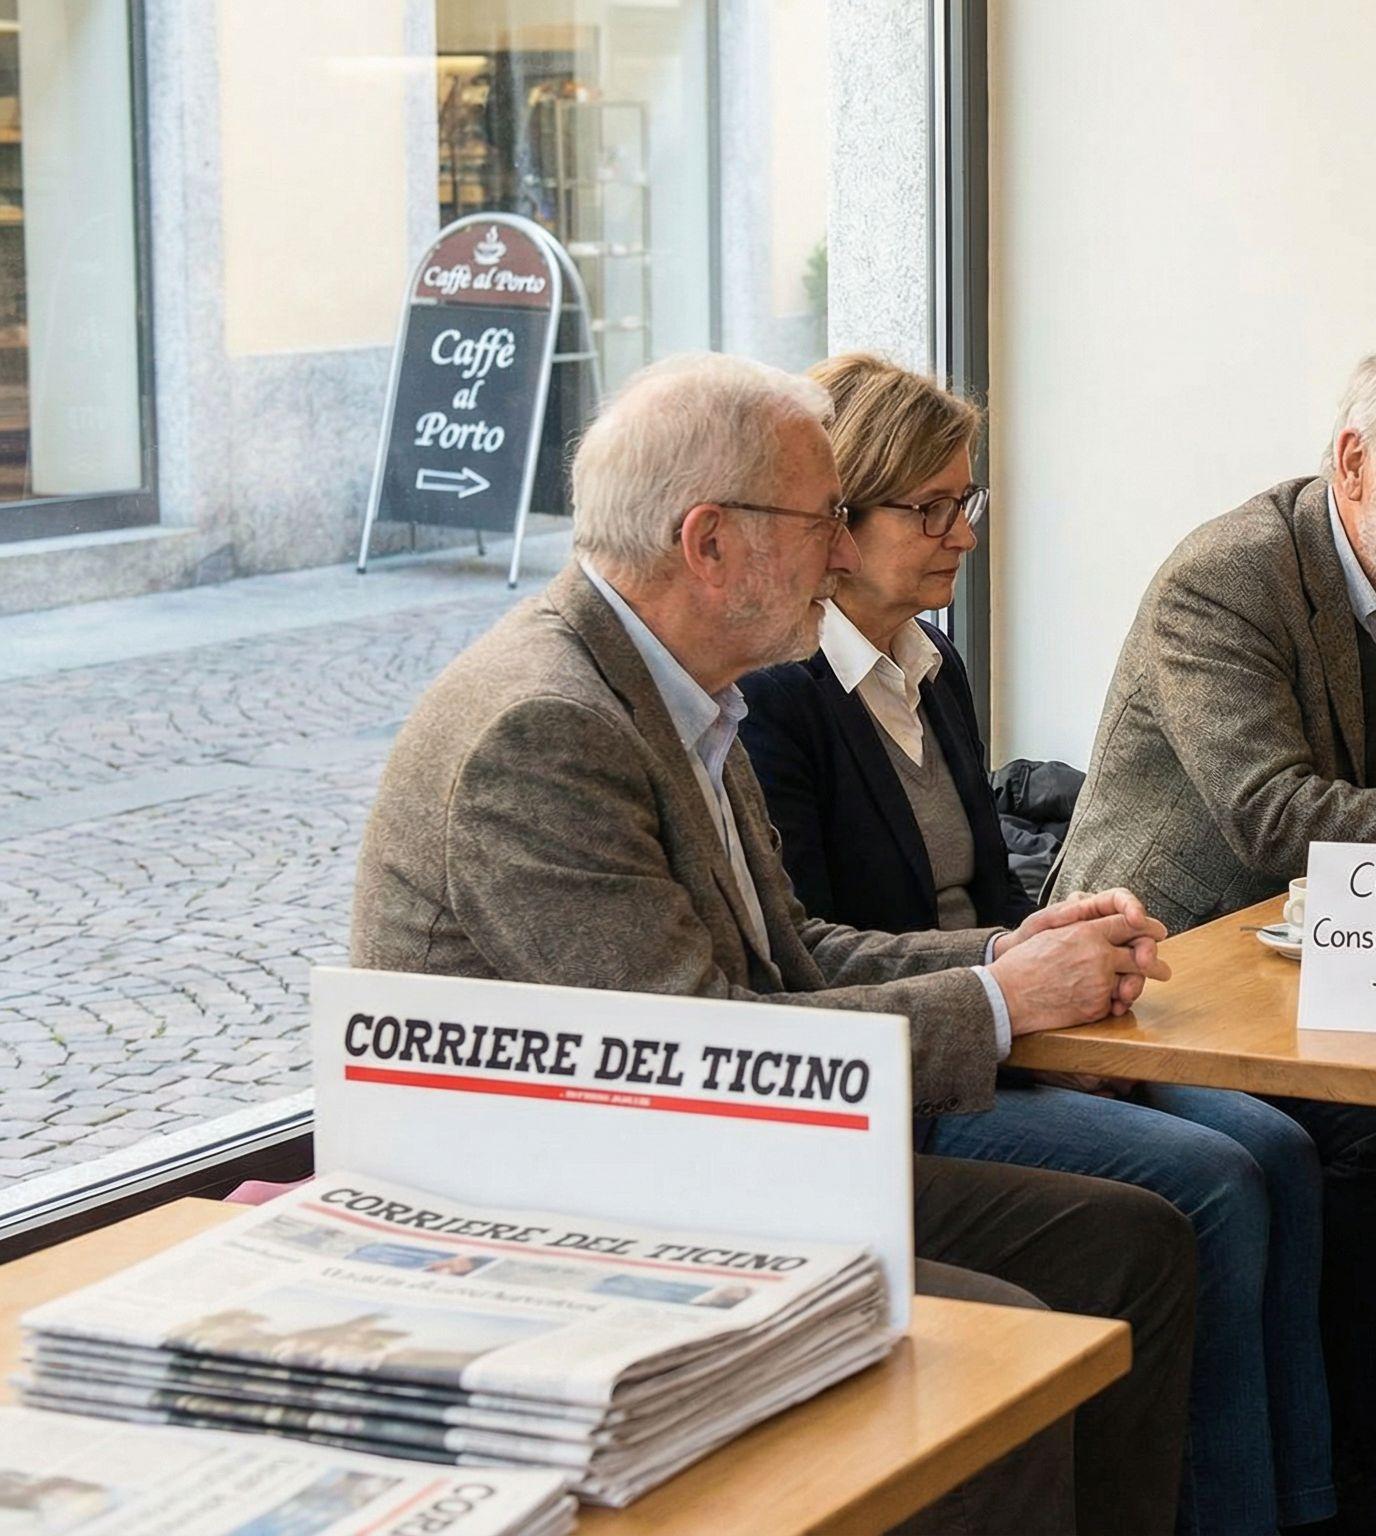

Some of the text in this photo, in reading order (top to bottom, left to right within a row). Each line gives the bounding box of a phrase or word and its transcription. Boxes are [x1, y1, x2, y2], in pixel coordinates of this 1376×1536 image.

[424, 264, 546, 295] Caffè al Porto
[431, 328, 516, 379] Caffè
[453, 379, 485, 410] al
[414, 411, 505, 453] Porto
[344, 1012, 870, 1105] CORRIERE DEL TICINO
[320, 1187, 809, 1272] CORRIERE DEL TICINO
